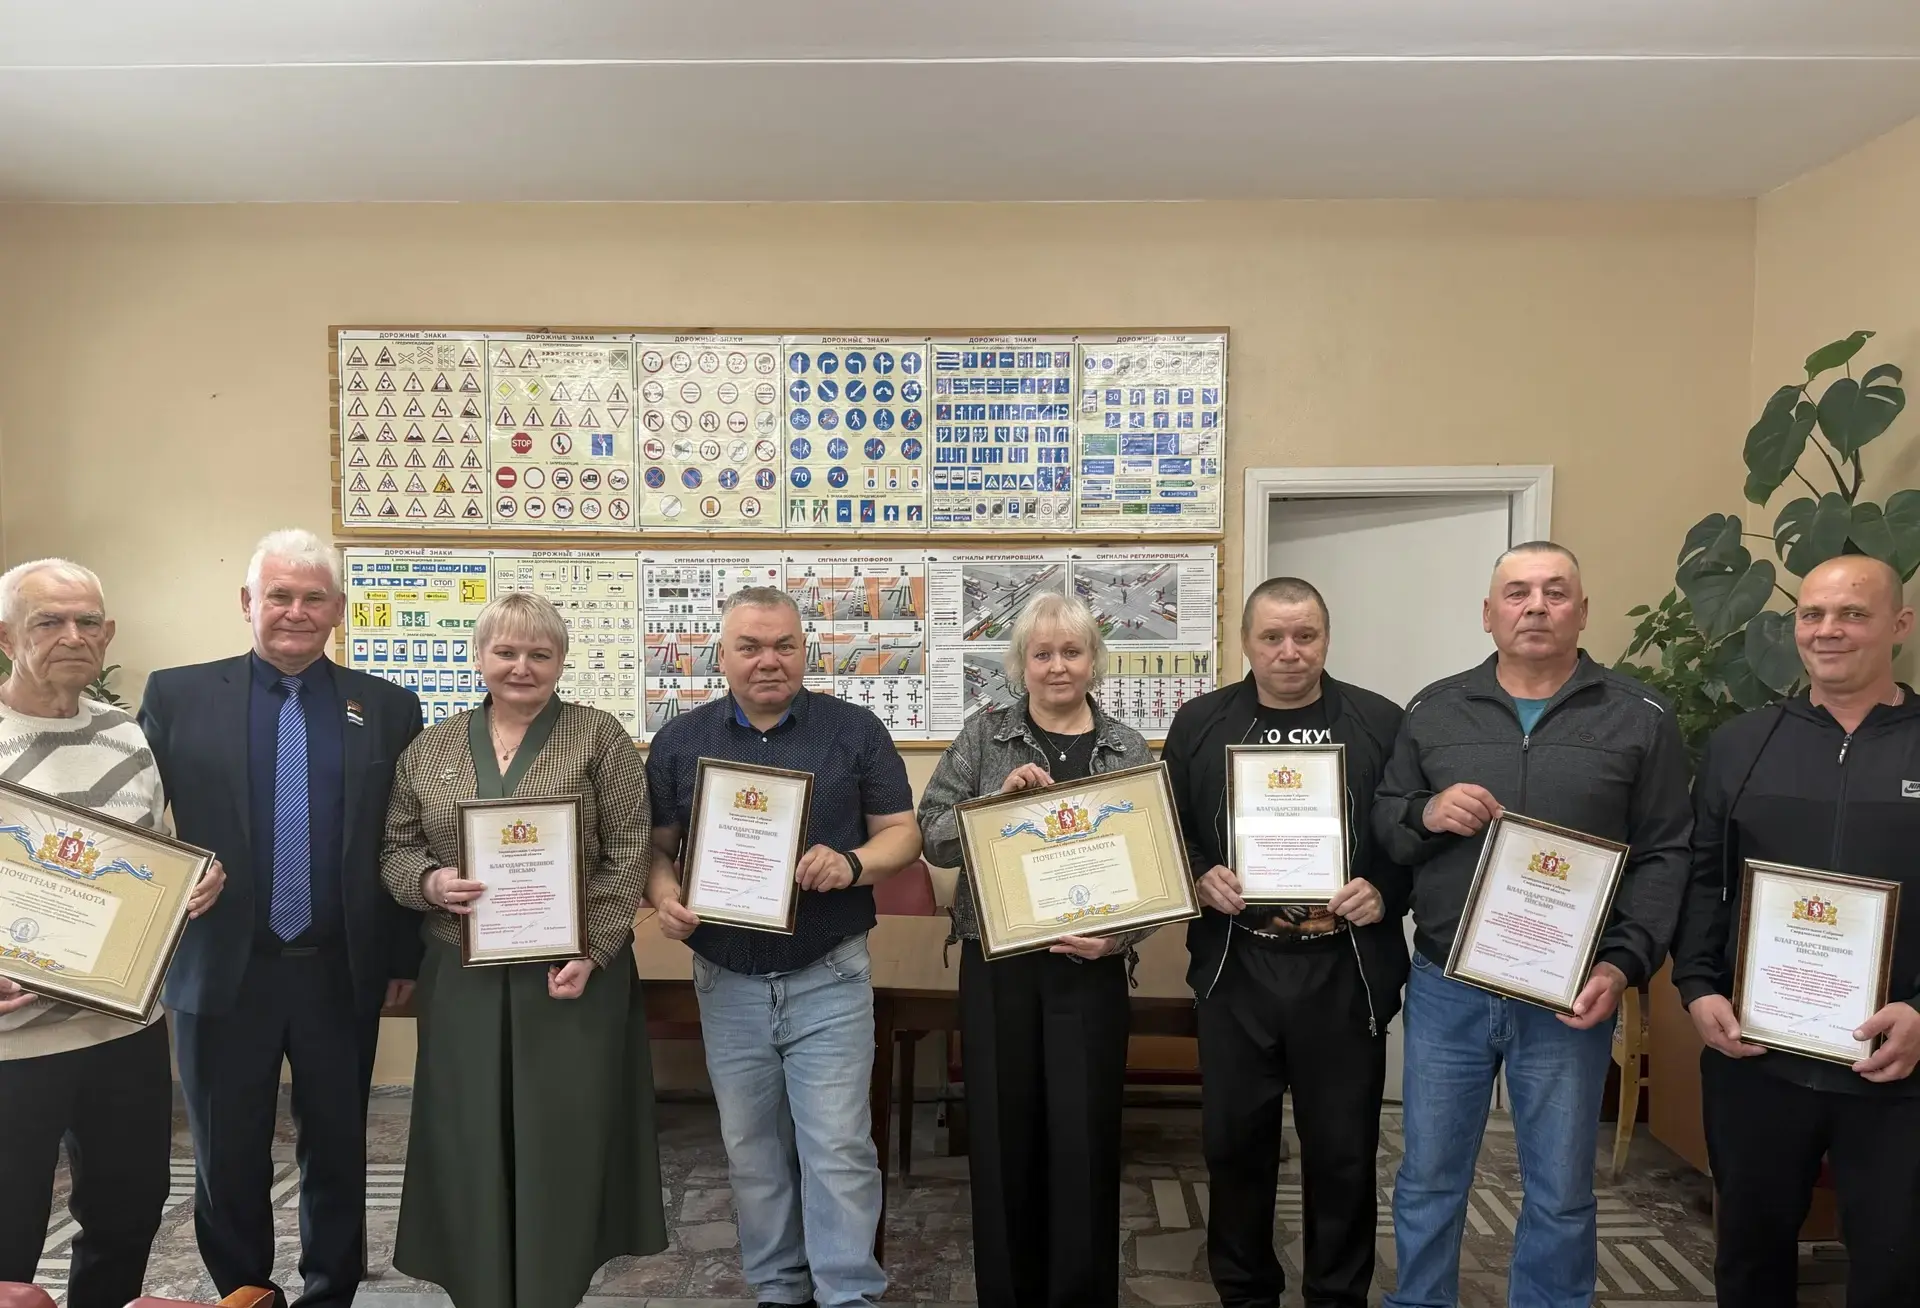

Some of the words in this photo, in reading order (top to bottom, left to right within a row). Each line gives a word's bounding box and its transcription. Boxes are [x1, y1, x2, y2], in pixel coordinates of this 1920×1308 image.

[1182, 390, 1191, 403] P
[512, 439, 532, 448] STOP
[704, 445, 716, 455] 70
[794, 472, 807, 482] 70
[831, 473, 845, 482] 70
[1010, 503, 1018, 512] P
[718, 823, 778, 837] БЛАГОДАРСТВЕННОЕ
[735, 832, 760, 841] ПИСЬМО
[1032, 848, 1077, 863] ПОЧЕТНАЯ
[1078, 840, 1116, 854] ГРАМОТА
[489, 860, 555, 869] БЛАГОДАРСТВЕННОЕ
[0, 866, 57, 890] ПОЧЕТНАЯ
[59, 885, 106, 906] ГРАМОТА
[1506, 884, 1576, 910] БЛАГОДАРСТВЕННОЕ
[1524, 897, 1554, 910] ПИСЬМО
[1774, 936, 1853, 956] БЛАГОДАРСТВЕННОЕ
[1796, 947, 1829, 958] ПИСЬМО
